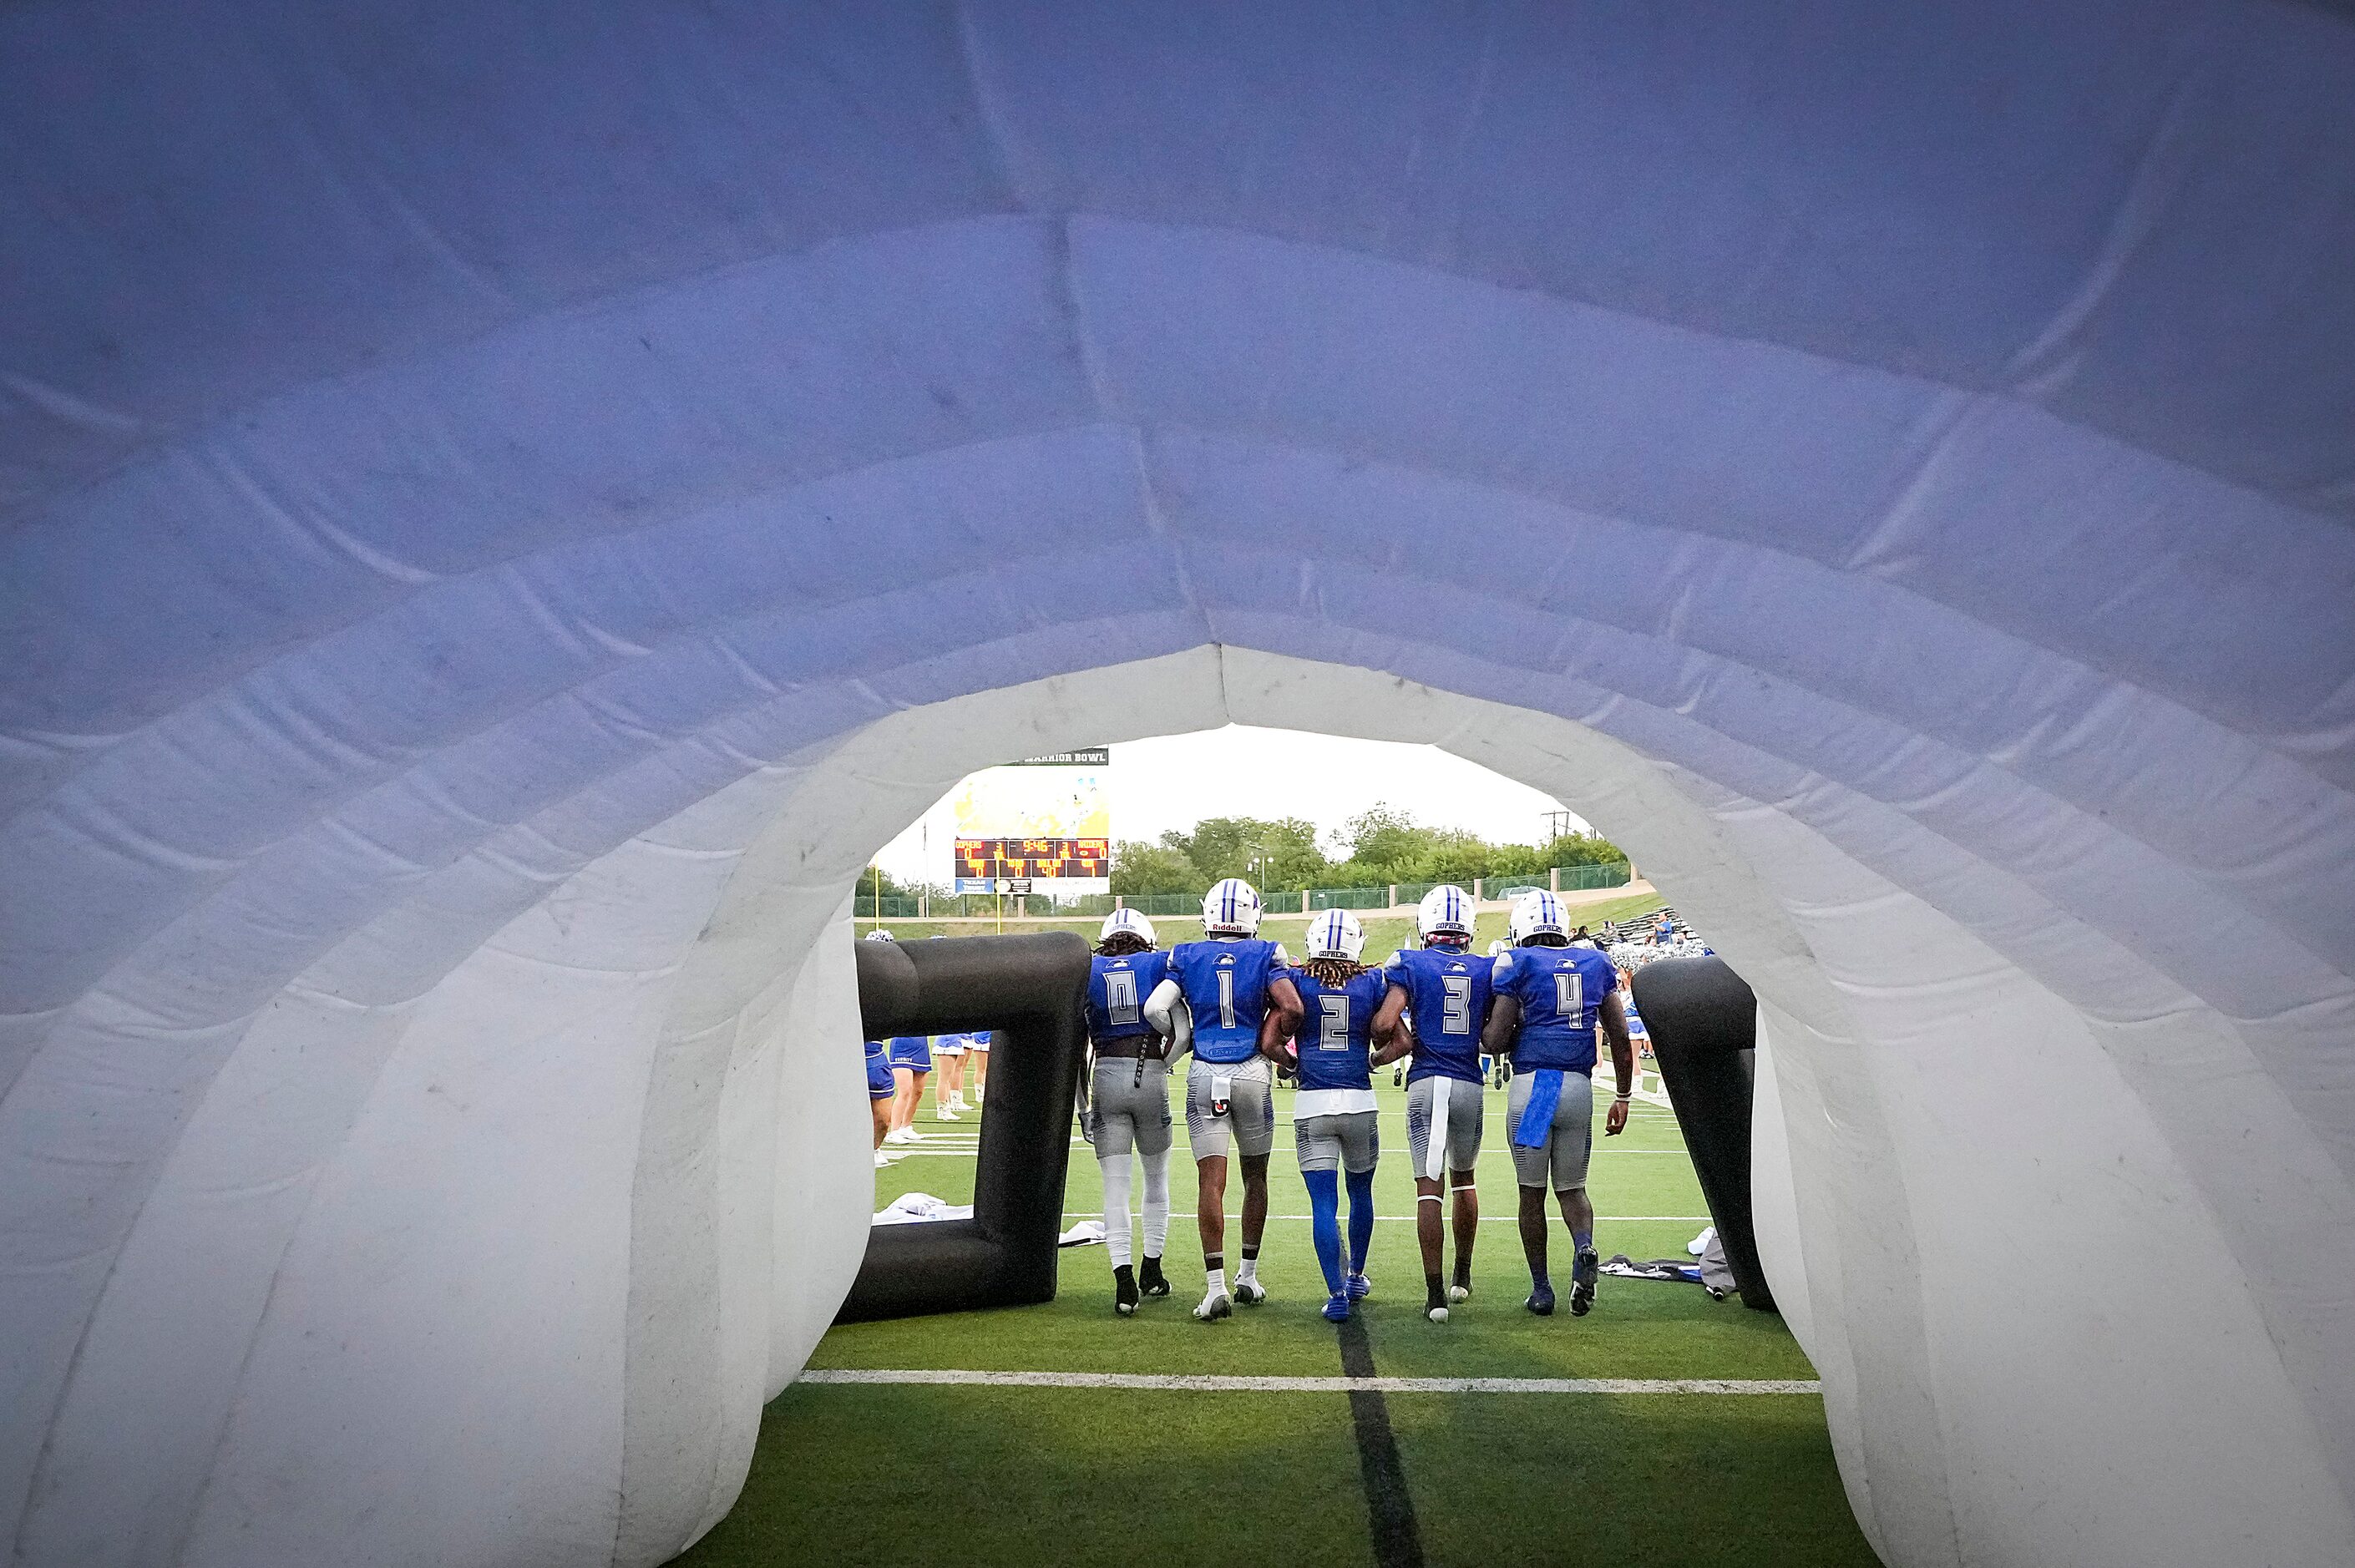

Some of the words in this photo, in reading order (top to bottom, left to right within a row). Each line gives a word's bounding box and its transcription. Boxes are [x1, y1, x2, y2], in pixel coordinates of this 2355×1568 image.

[1075, 753, 1106, 761] BOWL
[995, 842, 1002, 851] 3
[1023, 840, 1048, 852] 9:46
[1061, 842, 1068, 851] 3
[965, 848, 972, 858] 0
[1099, 847, 1107, 858] 0
[976, 867, 983, 878] 0
[1015, 867, 1022, 878] 0
[1041, 867, 1056, 878] 40
[1110, 923, 1137, 933] GOPHERS
[1213, 923, 1242, 932] Riddell
[1436, 922, 1465, 931] GOPHERS
[1533, 924, 1562, 933] GOPHERS
[1319, 950, 1348, 959] GOPHERS
[1102, 970, 1139, 1025] 0
[1216, 970, 1235, 1029] 1
[1553, 973, 1583, 1029] 4
[1441, 975, 1471, 1034] 3
[1318, 995, 1350, 1051] 2
